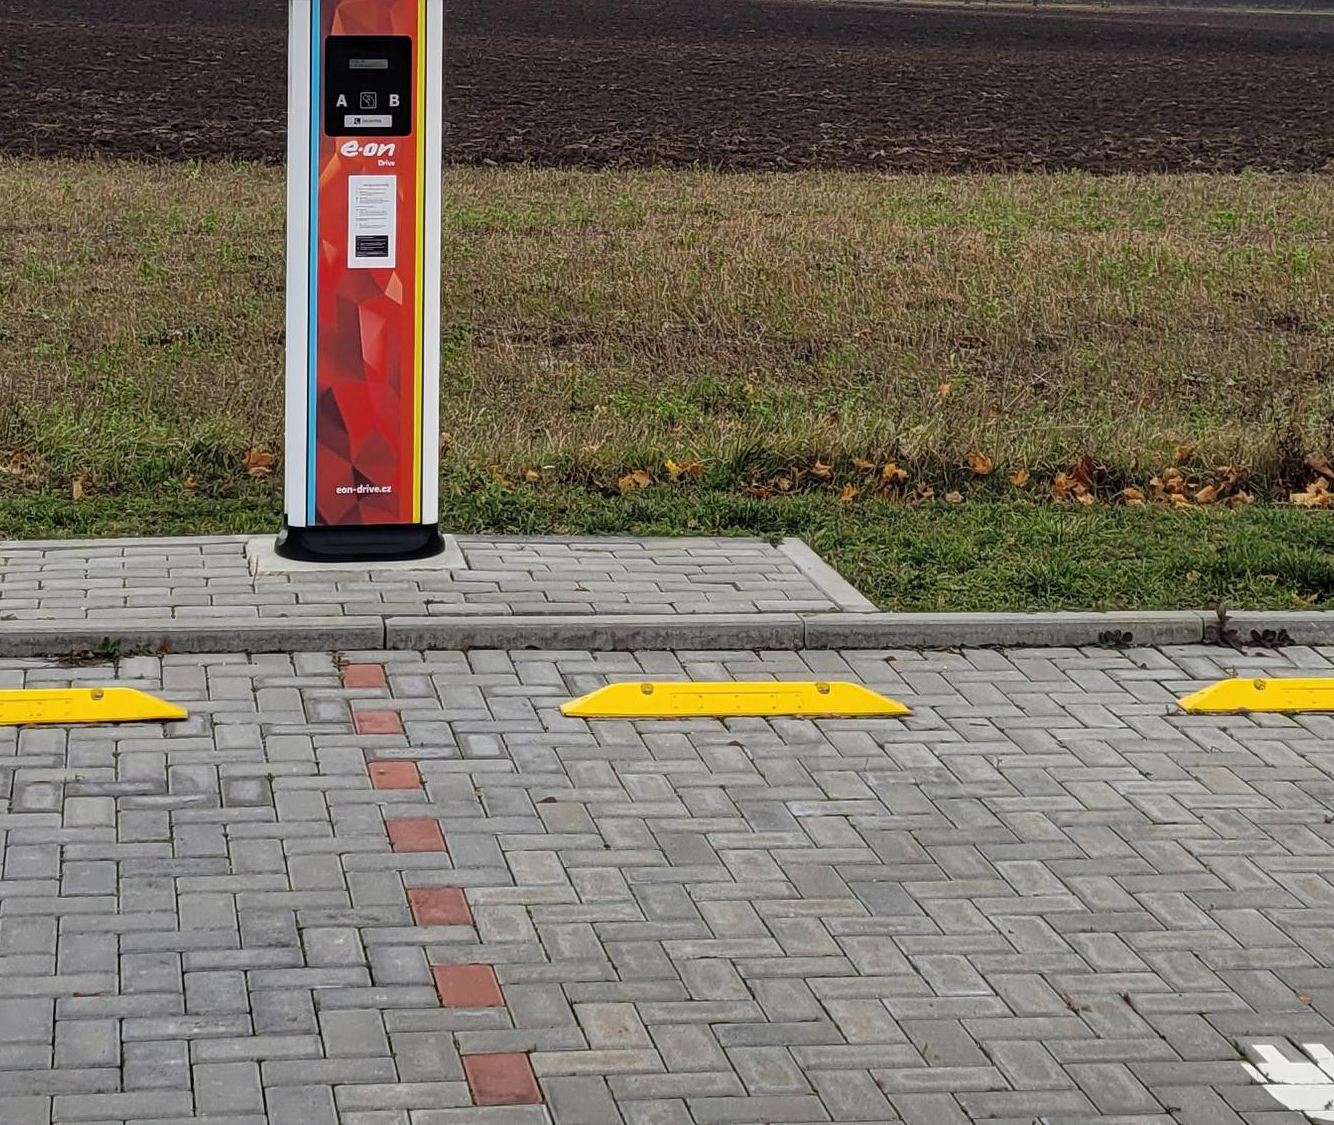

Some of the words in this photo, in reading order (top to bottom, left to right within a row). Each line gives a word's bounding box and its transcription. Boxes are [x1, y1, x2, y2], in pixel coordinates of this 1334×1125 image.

[336, 94, 348, 107] A
[389, 94, 400, 107] B
[336, 484, 392, 494] eon-drive.cz
